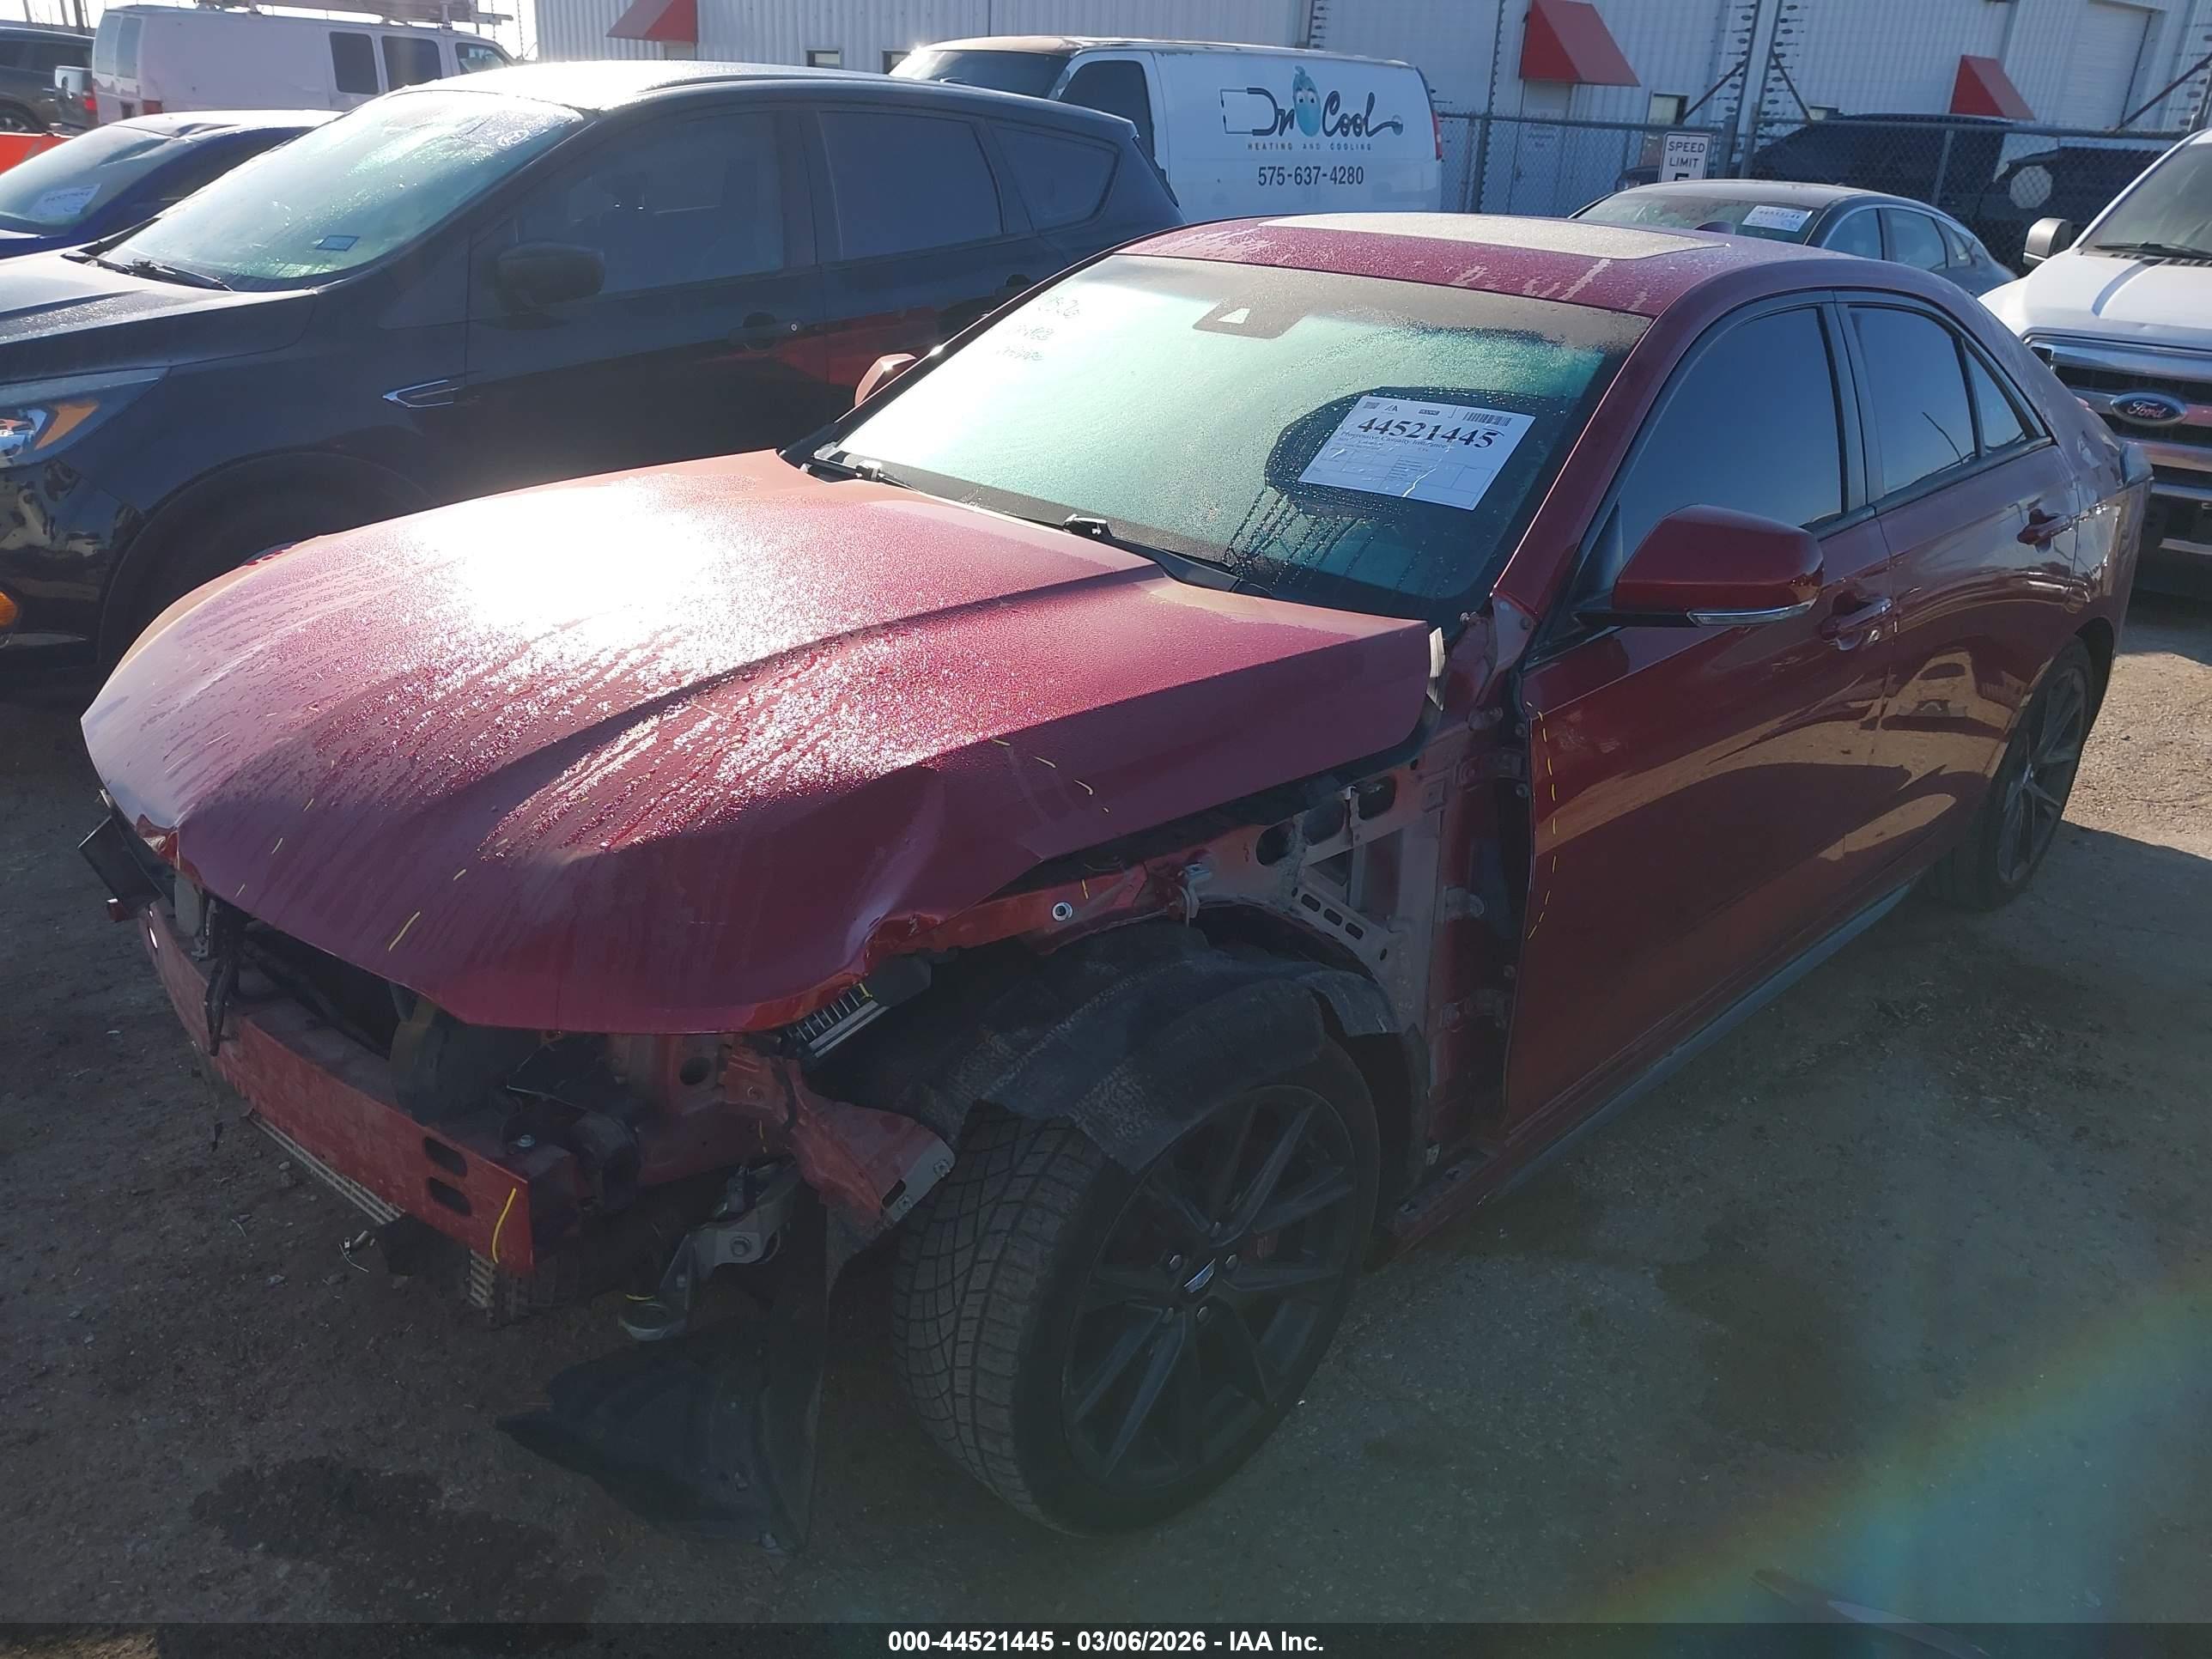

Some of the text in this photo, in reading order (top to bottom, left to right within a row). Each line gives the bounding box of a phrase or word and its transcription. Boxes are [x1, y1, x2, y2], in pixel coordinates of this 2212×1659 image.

[1322, 90, 1400, 137] Cool
[1247, 142, 1372, 151] HEATING AND COOLING
[1667, 140, 1705, 155] SPEED
[1668, 157, 1700, 169] LIMIT
[1257, 165, 1364, 186] 575-637-4280
[2126, 399, 2167, 419] Ford
[1357, 416, 1499, 448] 44521445
